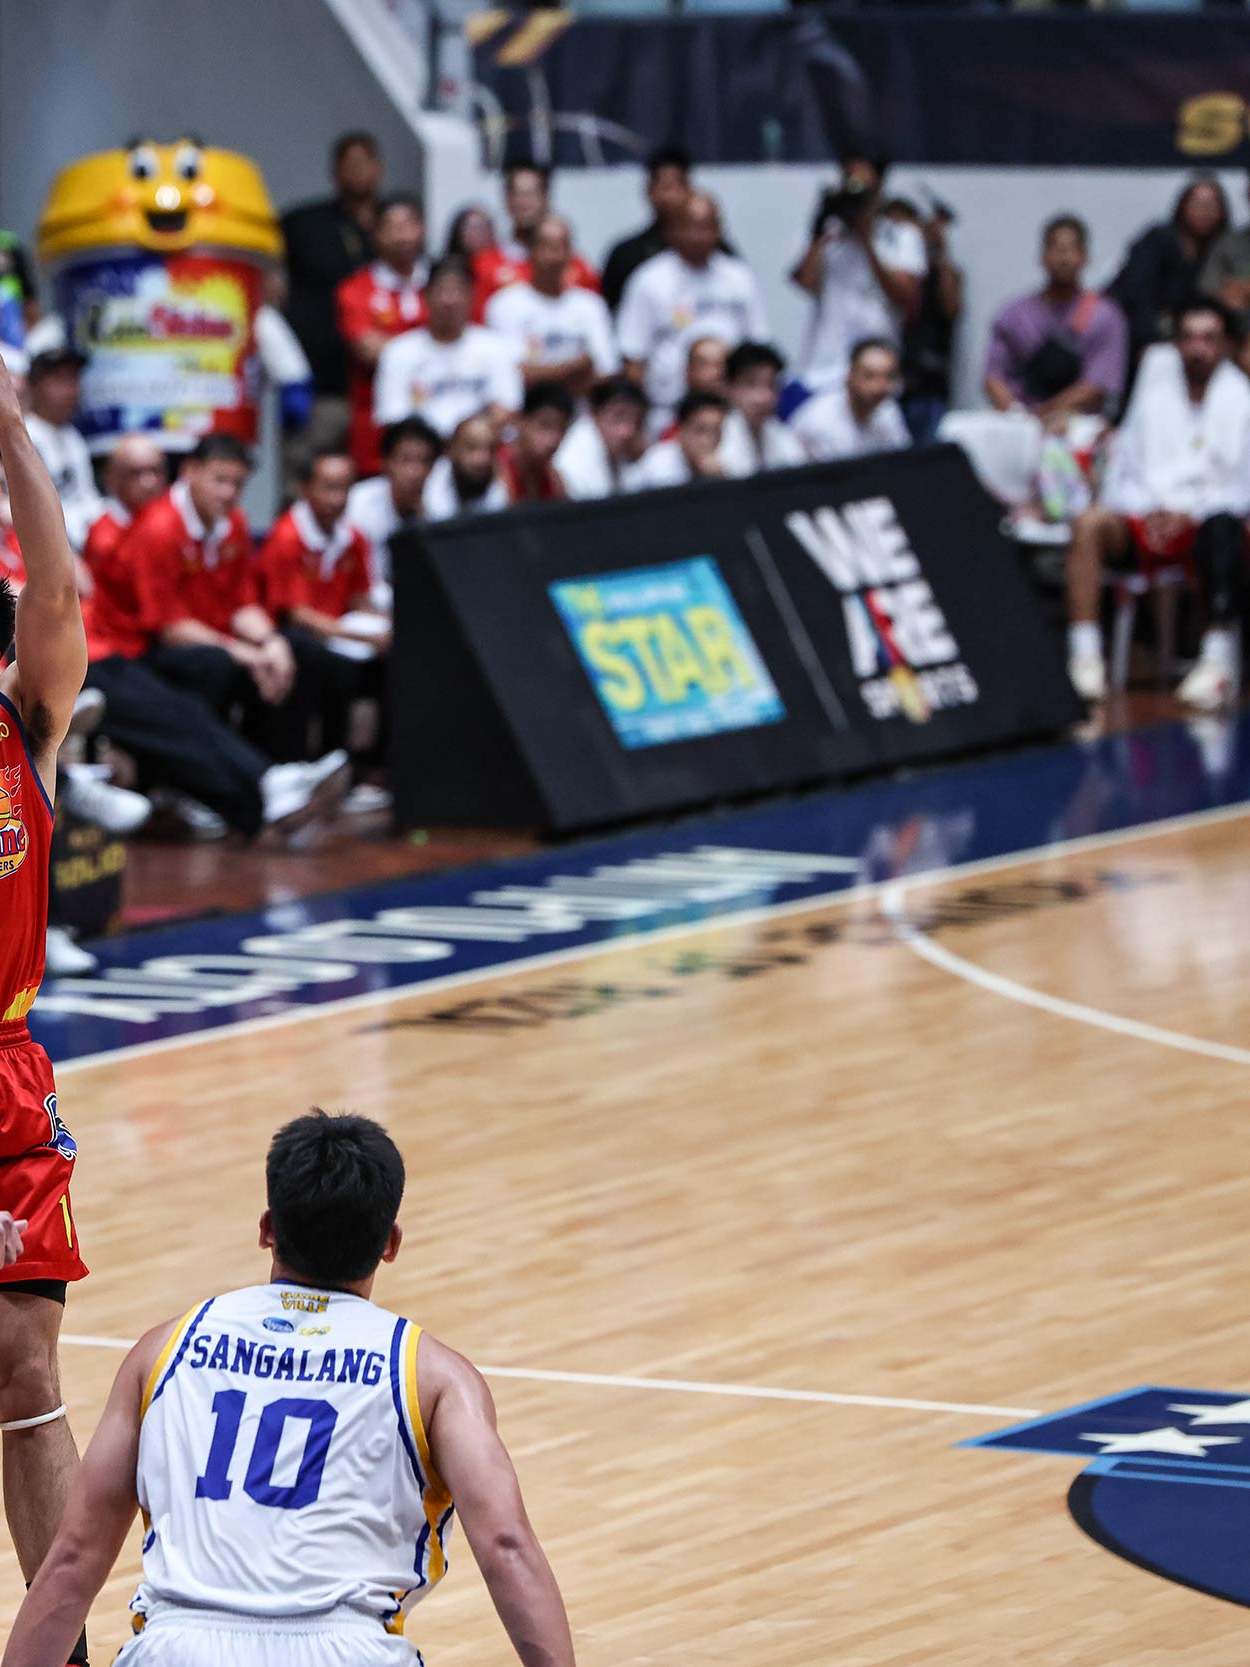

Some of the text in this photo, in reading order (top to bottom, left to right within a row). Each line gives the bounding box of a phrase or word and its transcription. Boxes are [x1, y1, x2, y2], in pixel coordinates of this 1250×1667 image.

[784, 496, 921, 592] WE
[582, 606, 758, 713] STAR
[190, 1333, 386, 1387] SANGALANG
[194, 1388, 340, 1511] 10
